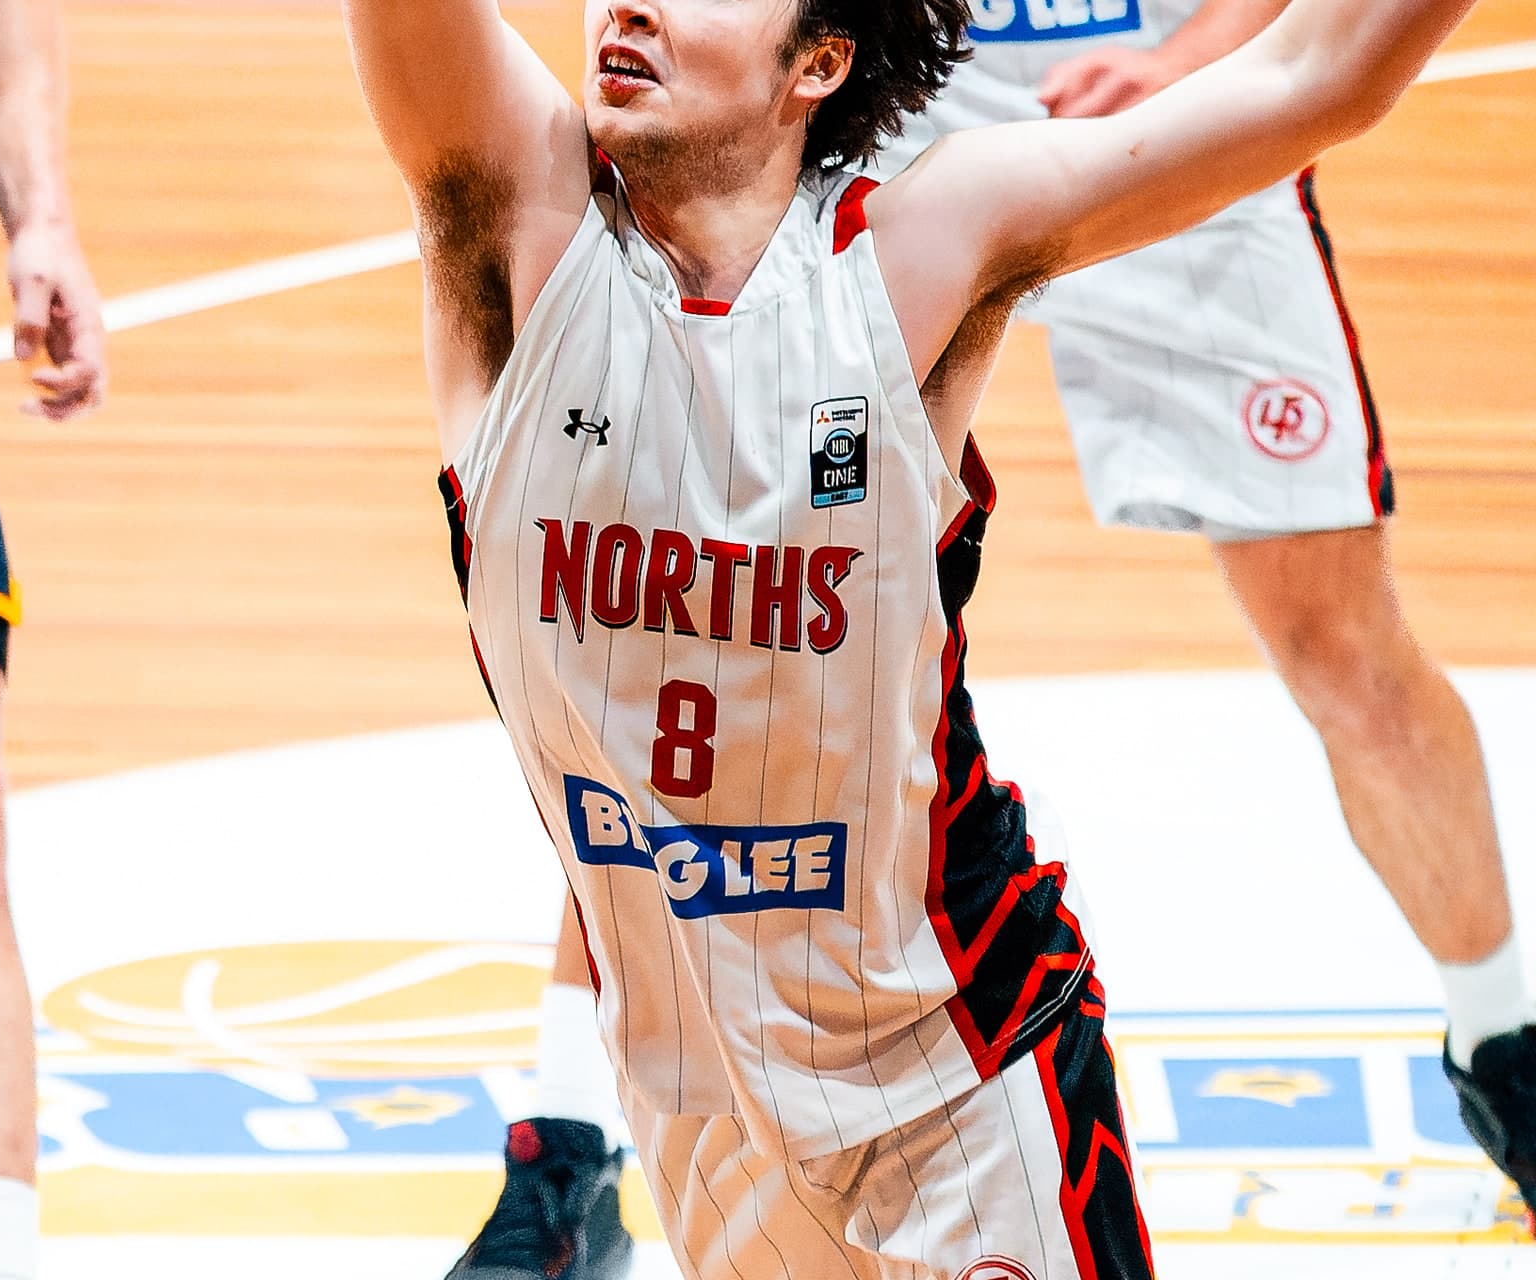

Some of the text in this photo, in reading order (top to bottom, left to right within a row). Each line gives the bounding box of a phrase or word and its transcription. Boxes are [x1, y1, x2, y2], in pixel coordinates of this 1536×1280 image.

[824, 464, 858, 489] ONE
[534, 517, 865, 656] NORTHS
[650, 678, 718, 800] 8
[721, 834, 833, 898] LEE
